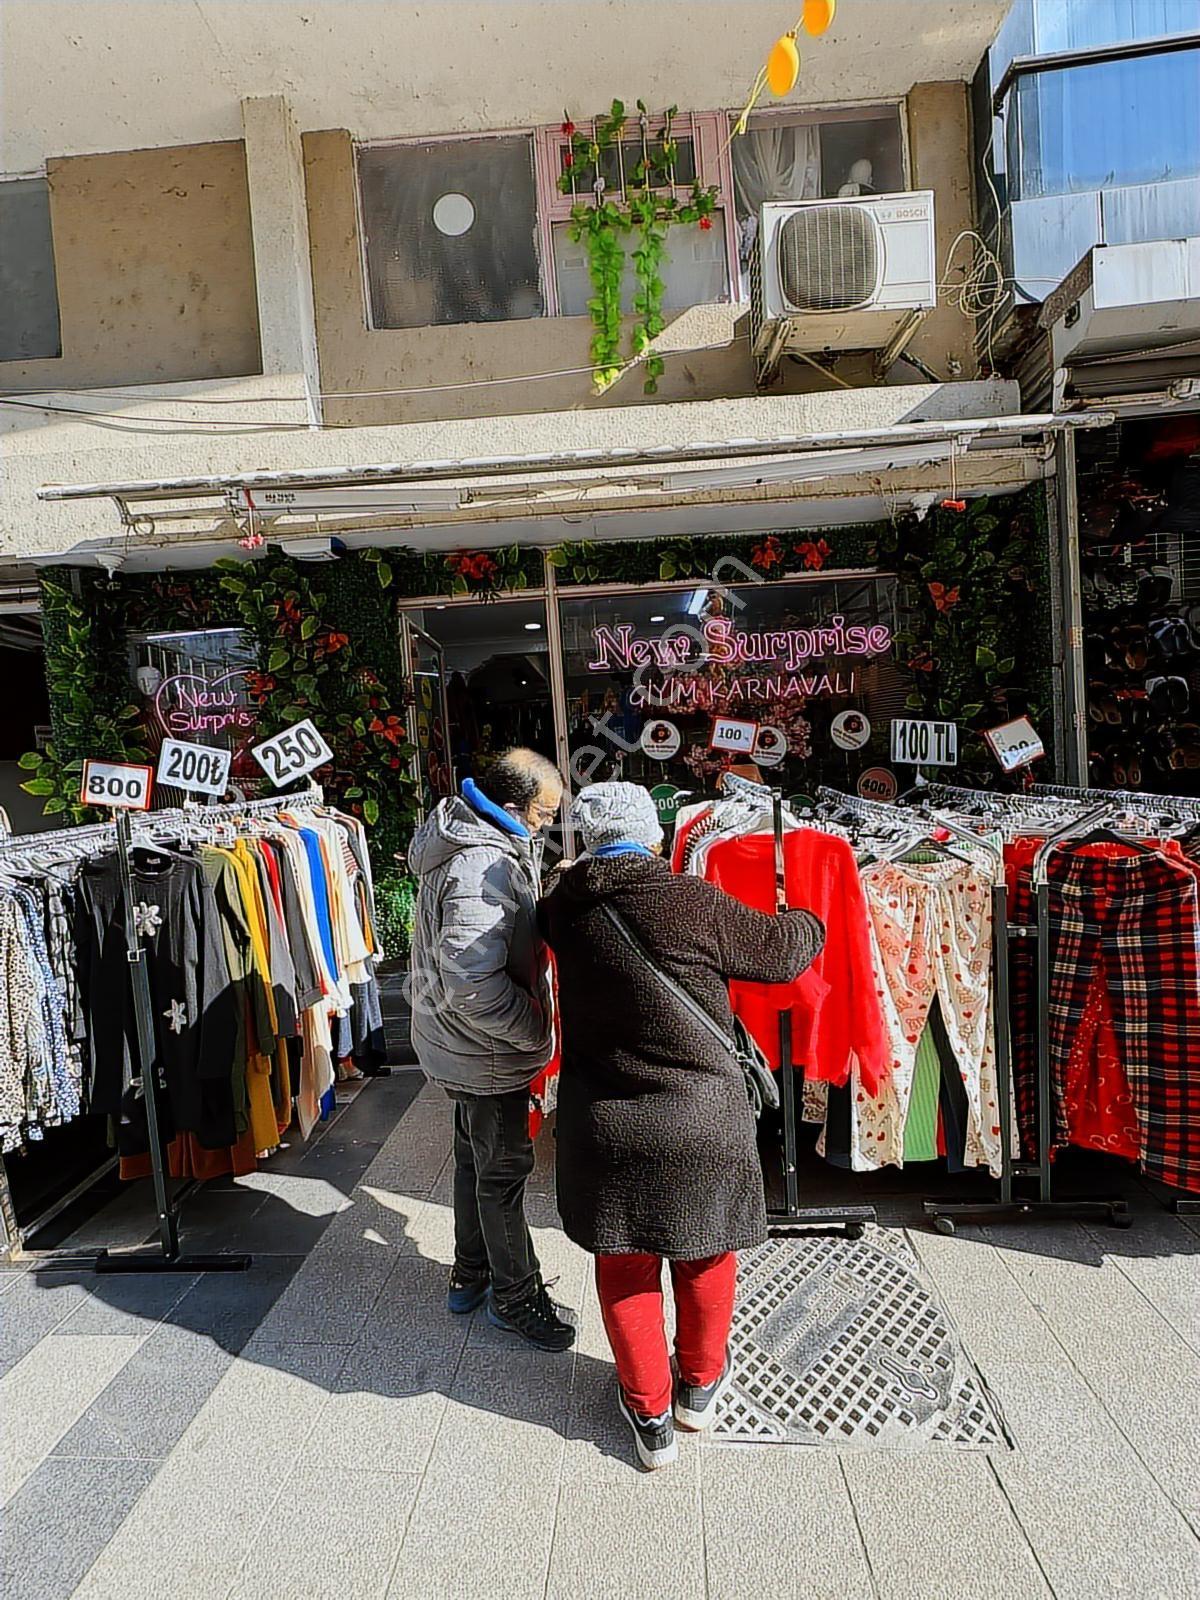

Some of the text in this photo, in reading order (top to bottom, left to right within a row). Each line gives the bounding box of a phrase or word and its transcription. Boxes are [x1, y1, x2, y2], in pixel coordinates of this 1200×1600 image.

[896, 207, 927, 218] BOSCH
[589, 616, 892, 671] New Surprise
[174, 679, 239, 710] New
[708, 671, 856, 704] KARNAVALI
[717, 727, 742, 741] 100
[899, 722, 929, 761] 100
[934, 723, 956, 763] TL
[166, 747, 225, 787] 200₺
[261, 727, 322, 780] 250
[88, 775, 142, 799] 800
